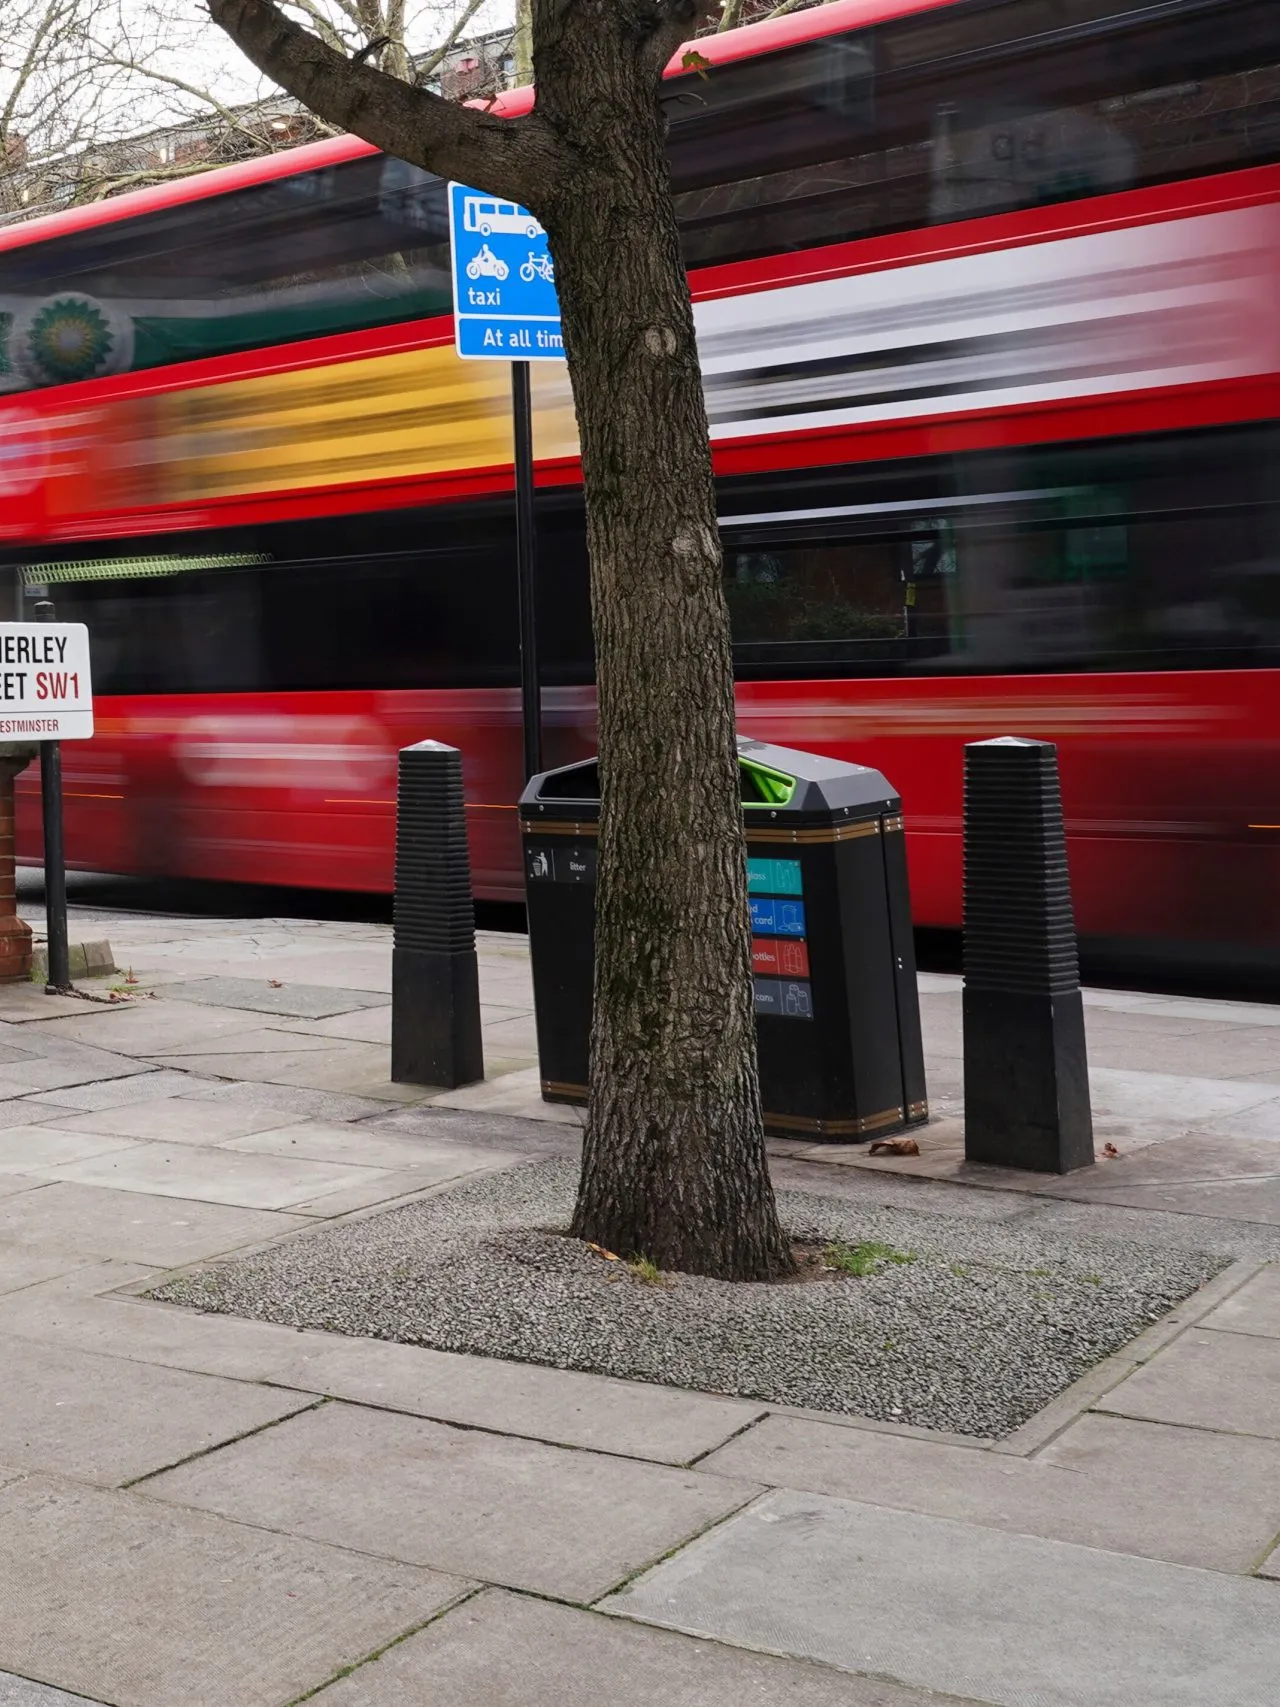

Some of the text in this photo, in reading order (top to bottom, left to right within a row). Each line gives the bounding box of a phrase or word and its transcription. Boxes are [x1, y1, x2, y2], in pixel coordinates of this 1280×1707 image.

[468, 286, 501, 306] taxi
[483, 328, 564, 348] At all tim
[36, 671, 80, 700] SW1
[752, 951, 776, 962] ottles
